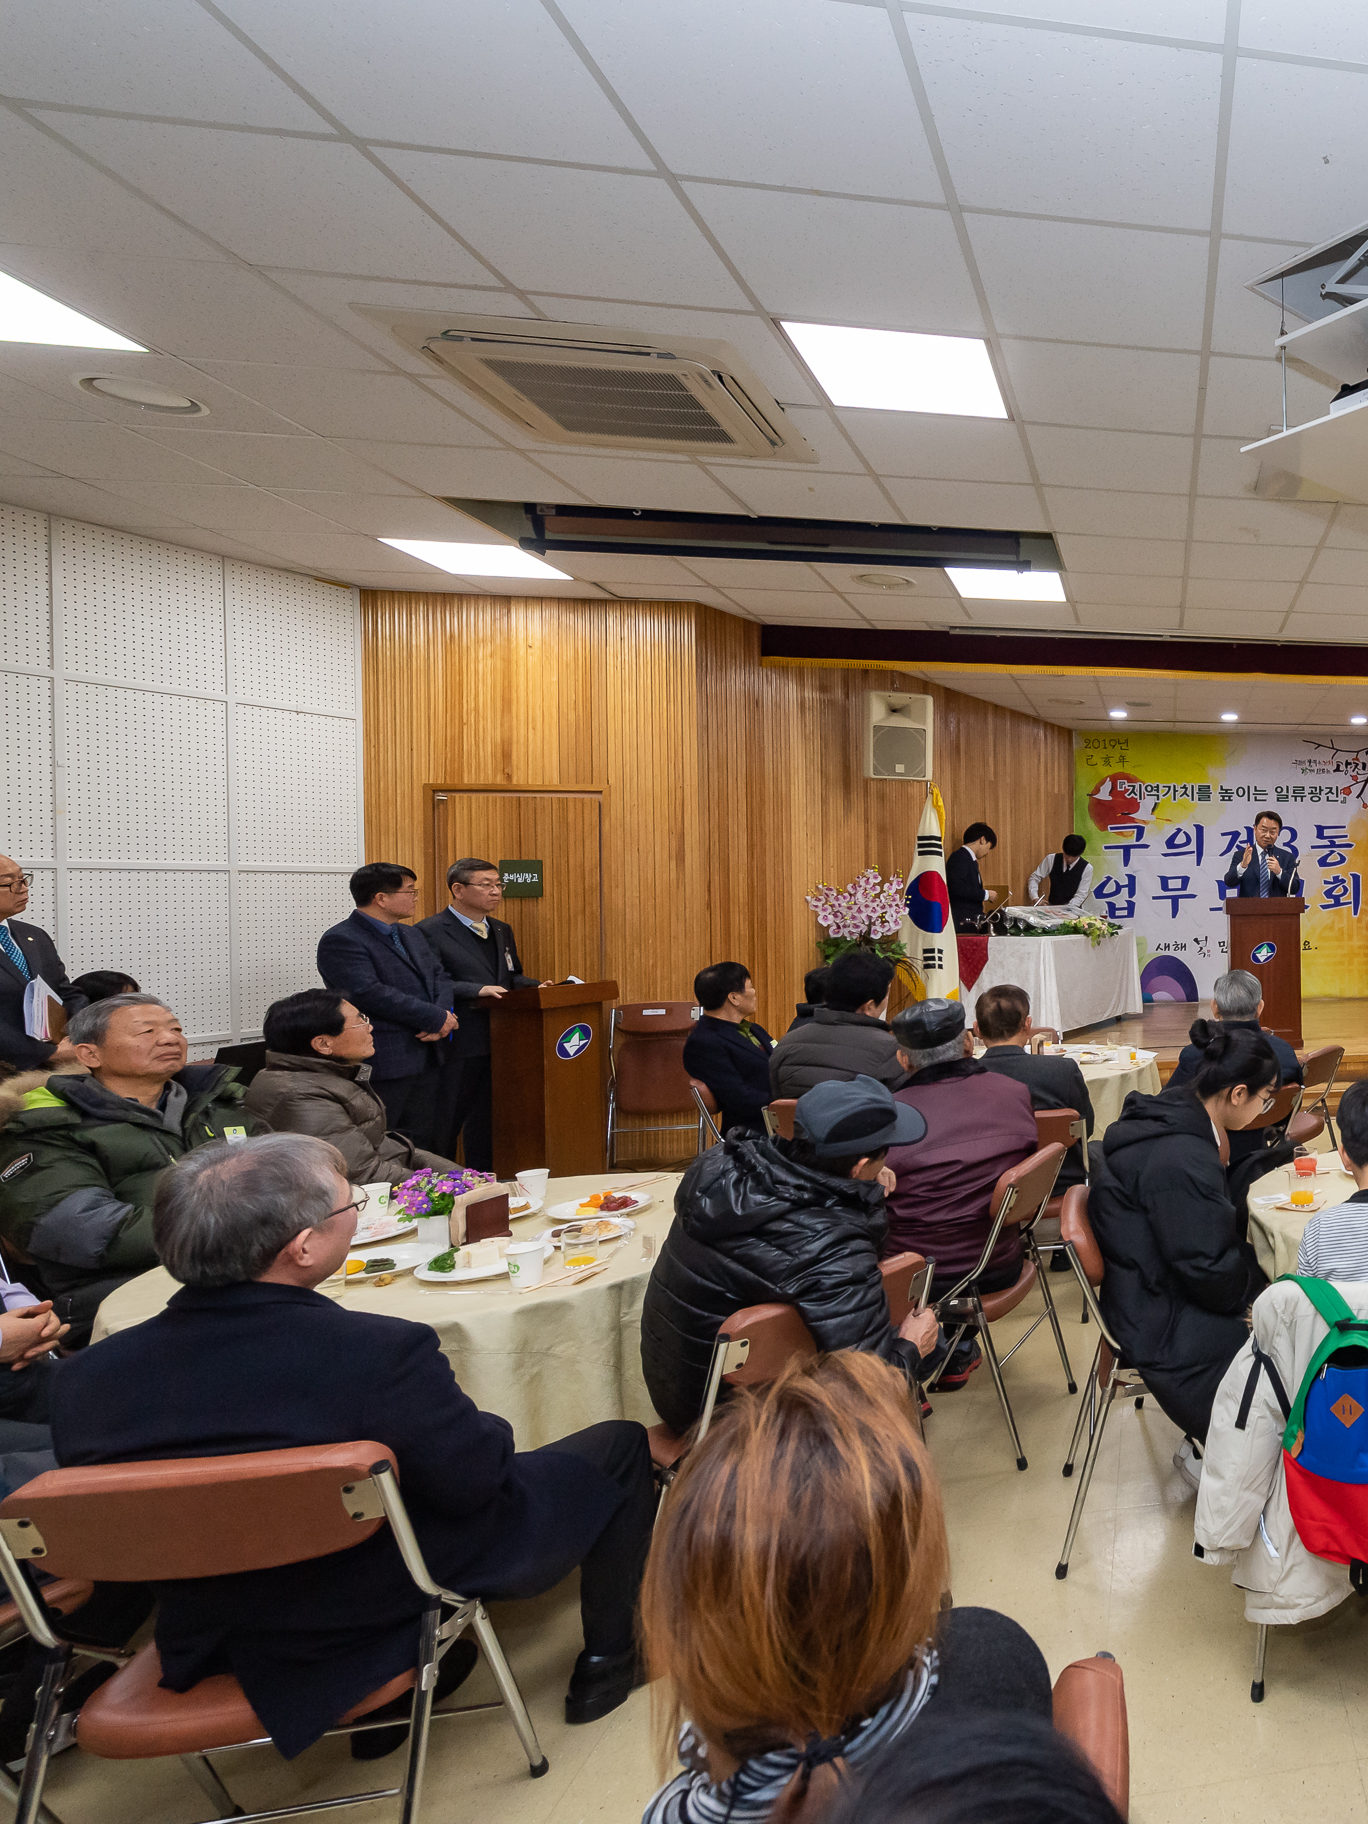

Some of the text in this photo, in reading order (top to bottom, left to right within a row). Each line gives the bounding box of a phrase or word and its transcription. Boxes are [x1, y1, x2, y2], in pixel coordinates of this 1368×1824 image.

[1084, 738, 1130, 751] 2019년
[1218, 785, 1269, 802] 높이는
[1155, 941, 1187, 952] 새해
